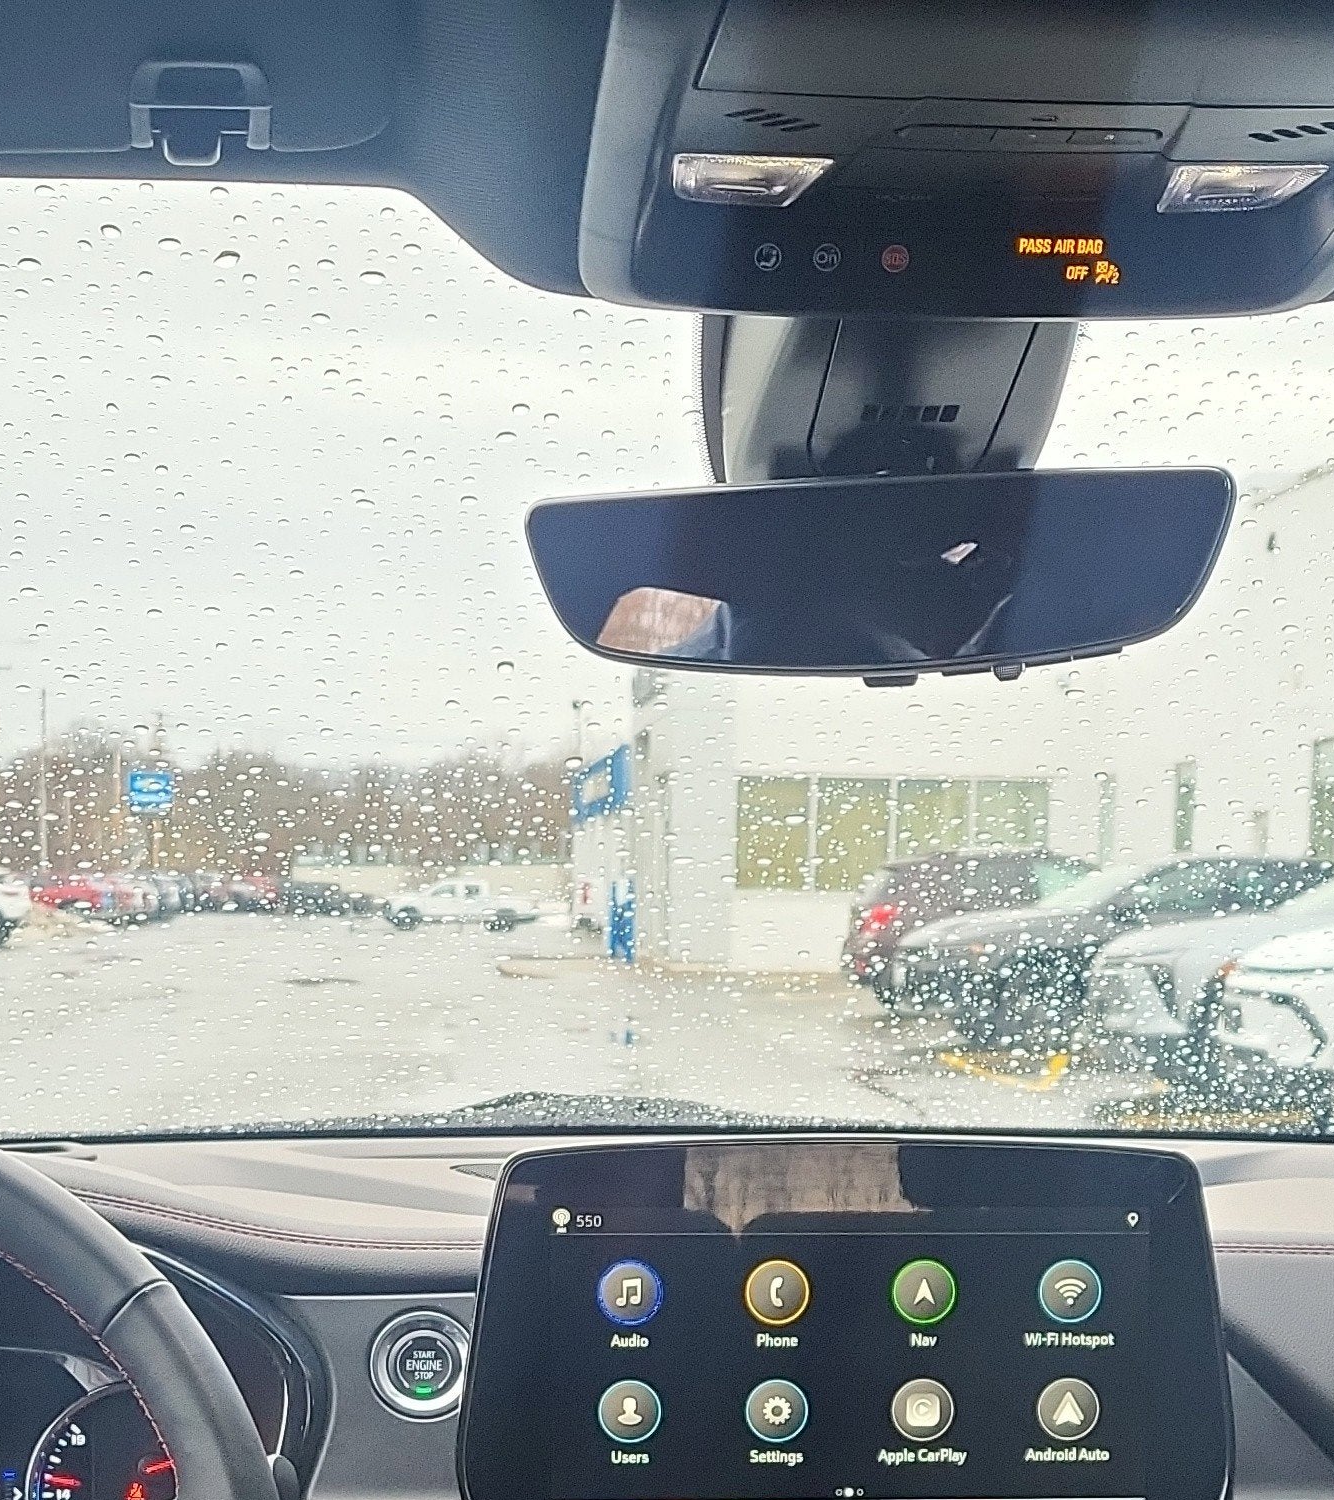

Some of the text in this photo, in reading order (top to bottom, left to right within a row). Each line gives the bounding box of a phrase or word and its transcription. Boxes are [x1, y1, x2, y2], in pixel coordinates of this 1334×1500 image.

[1019, 238, 1104, 255] PASS AIR BAG
[1066, 265, 1088, 281] OFF
[576, 1215, 602, 1228] 550
[610, 1333, 650, 1348] Audio
[756, 1333, 799, 1348] Phone
[909, 1332, 938, 1347] Nav
[1024, 1332, 1115, 1349] Wi-Fi Hotspot
[413, 1351, 436, 1359] START
[405, 1360, 443, 1371] ENGINE
[414, 1372, 434, 1380] STOP
[611, 1450, 650, 1464] Users
[749, 1450, 804, 1466] Settings
[877, 1448, 967, 1465] Apple CarPlay
[1025, 1447, 1110, 1462] Android Auto
